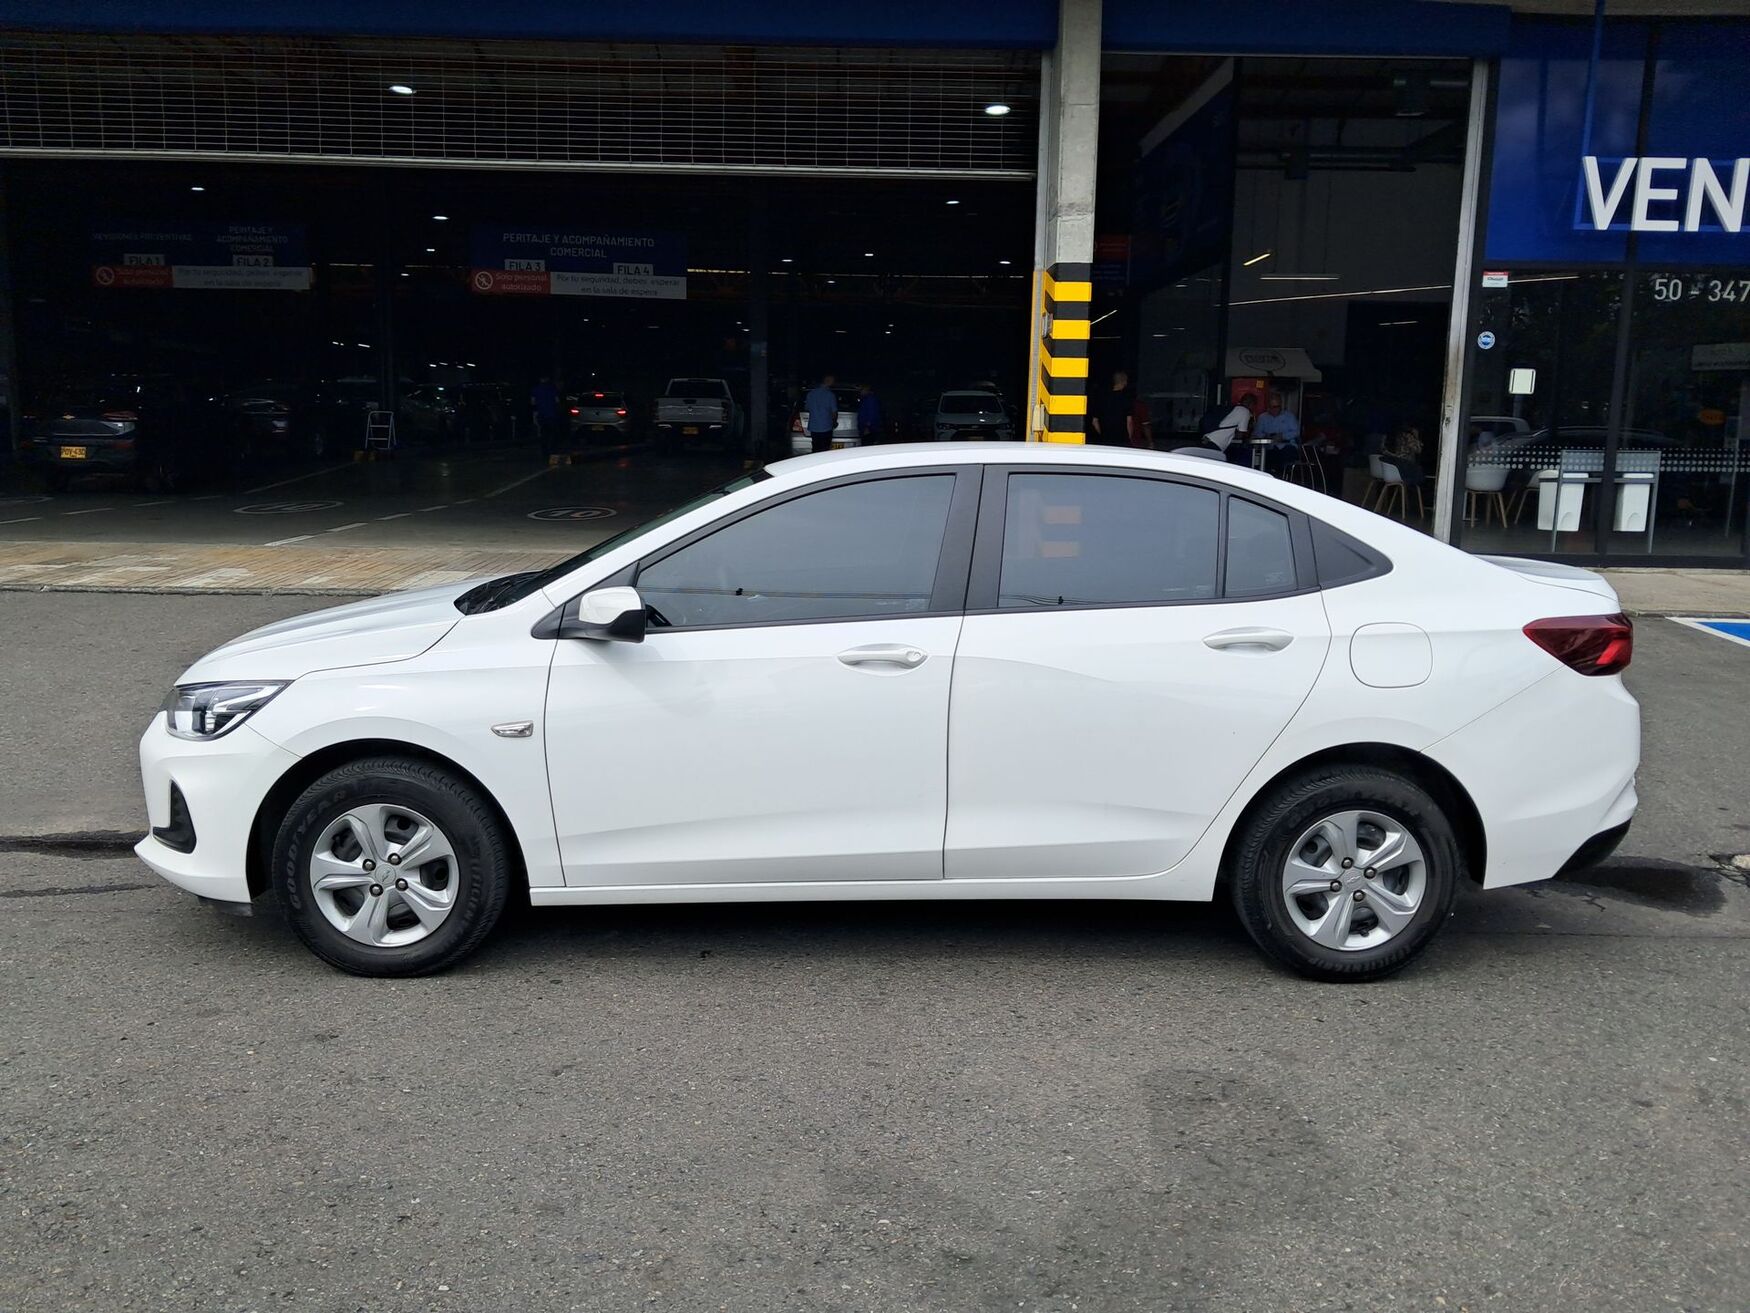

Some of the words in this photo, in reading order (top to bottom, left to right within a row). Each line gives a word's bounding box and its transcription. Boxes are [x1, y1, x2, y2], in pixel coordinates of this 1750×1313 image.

[1583, 156, 1750, 232] VEN
[503, 232, 550, 244] PERITAJE
[553, 234, 560, 244] Y
[560, 234, 655, 248] ACOMPAÑAMIENTO
[550, 247, 608, 258] COMERCIAL
[509, 261, 532, 271] FILA
[535, 262, 541, 271] 3
[617, 265, 642, 275] FILA
[643, 266, 650, 275] 4
[1654, 279, 1682, 300] 50
[1708, 280, 1750, 302] 347
